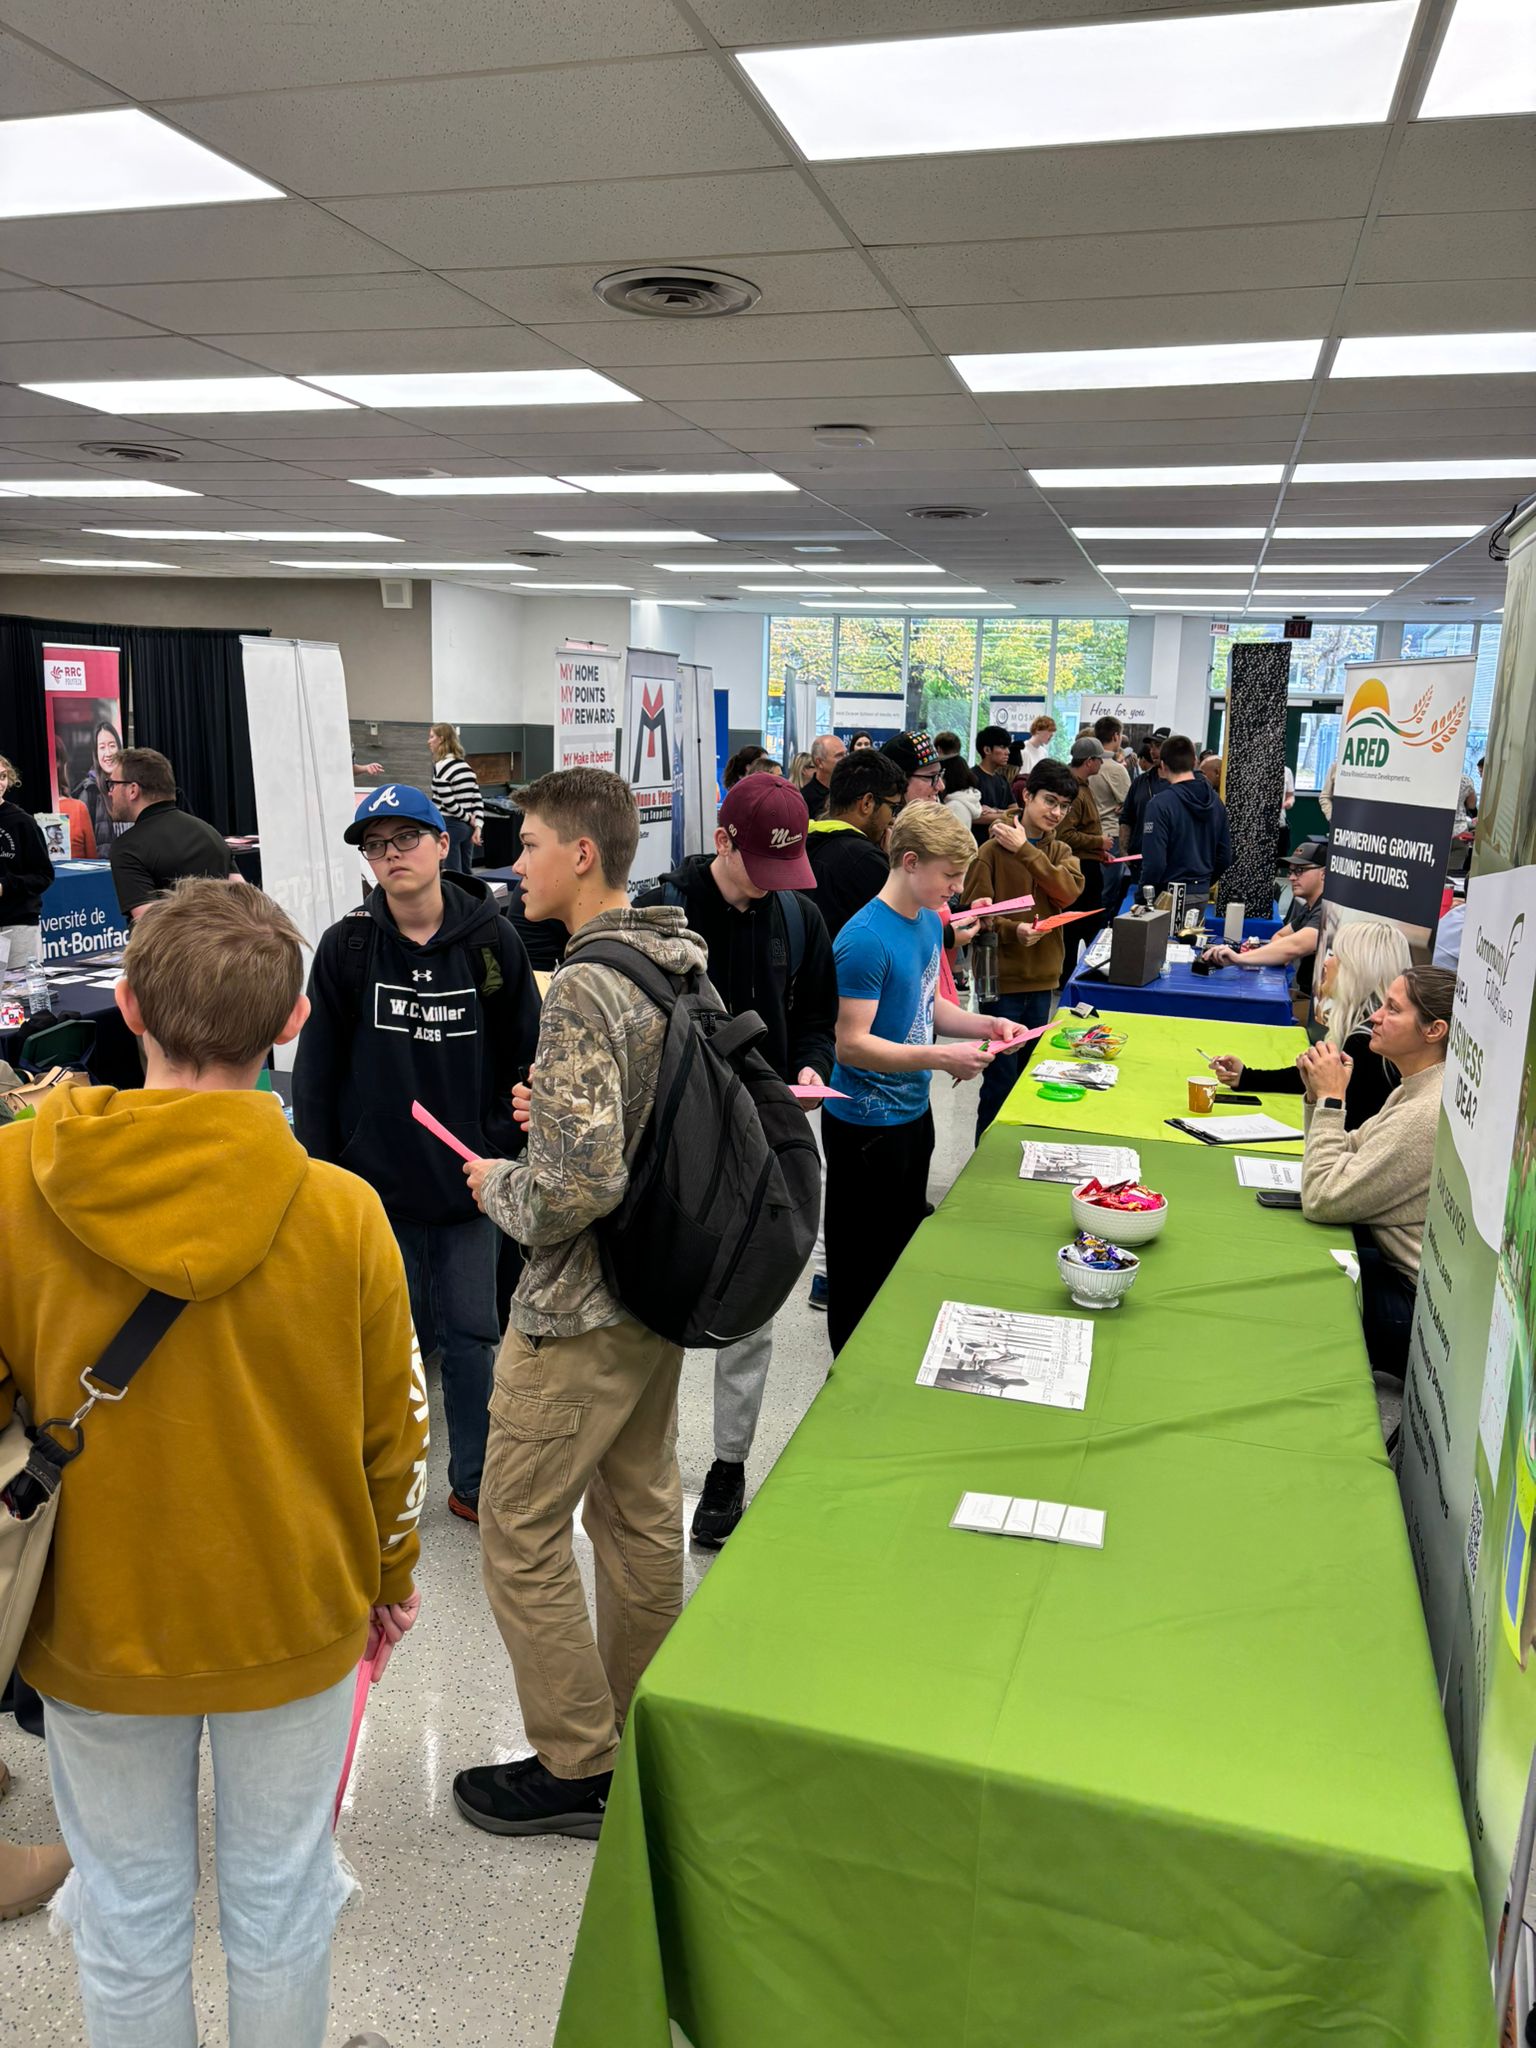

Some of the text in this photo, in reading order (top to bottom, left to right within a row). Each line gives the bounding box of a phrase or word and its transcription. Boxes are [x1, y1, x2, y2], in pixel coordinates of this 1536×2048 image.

[1287, 623, 1308, 637] EXIT
[64, 666, 82, 677] RRC
[560, 662, 600, 682] MY HOME
[560, 685, 606, 703] MY POINTS
[561, 707, 616, 725] MY REWARDS
[1011, 713, 1035, 721] MOSM
[1090, 701, 1146, 720] Here for you
[573, 751, 590, 765] Make
[1342, 737, 1390, 768] ARED
[368, 785, 400, 812] A
[658, 790, 673, 804] Yate
[1333, 827, 1436, 867] EMPOWERING GROWTH,
[1330, 855, 1409, 890] BUILDING FUTURES.
[38, 907, 106, 933] iversité de
[43, 926, 130, 960] int-Bonifac
[413, 1026, 442, 1042] ACES
[1449, 1013, 1484, 1089] USINESS
[1454, 1073, 1478, 1130] IDEA?
[1443, 1186, 1467, 1247] SERVICES
